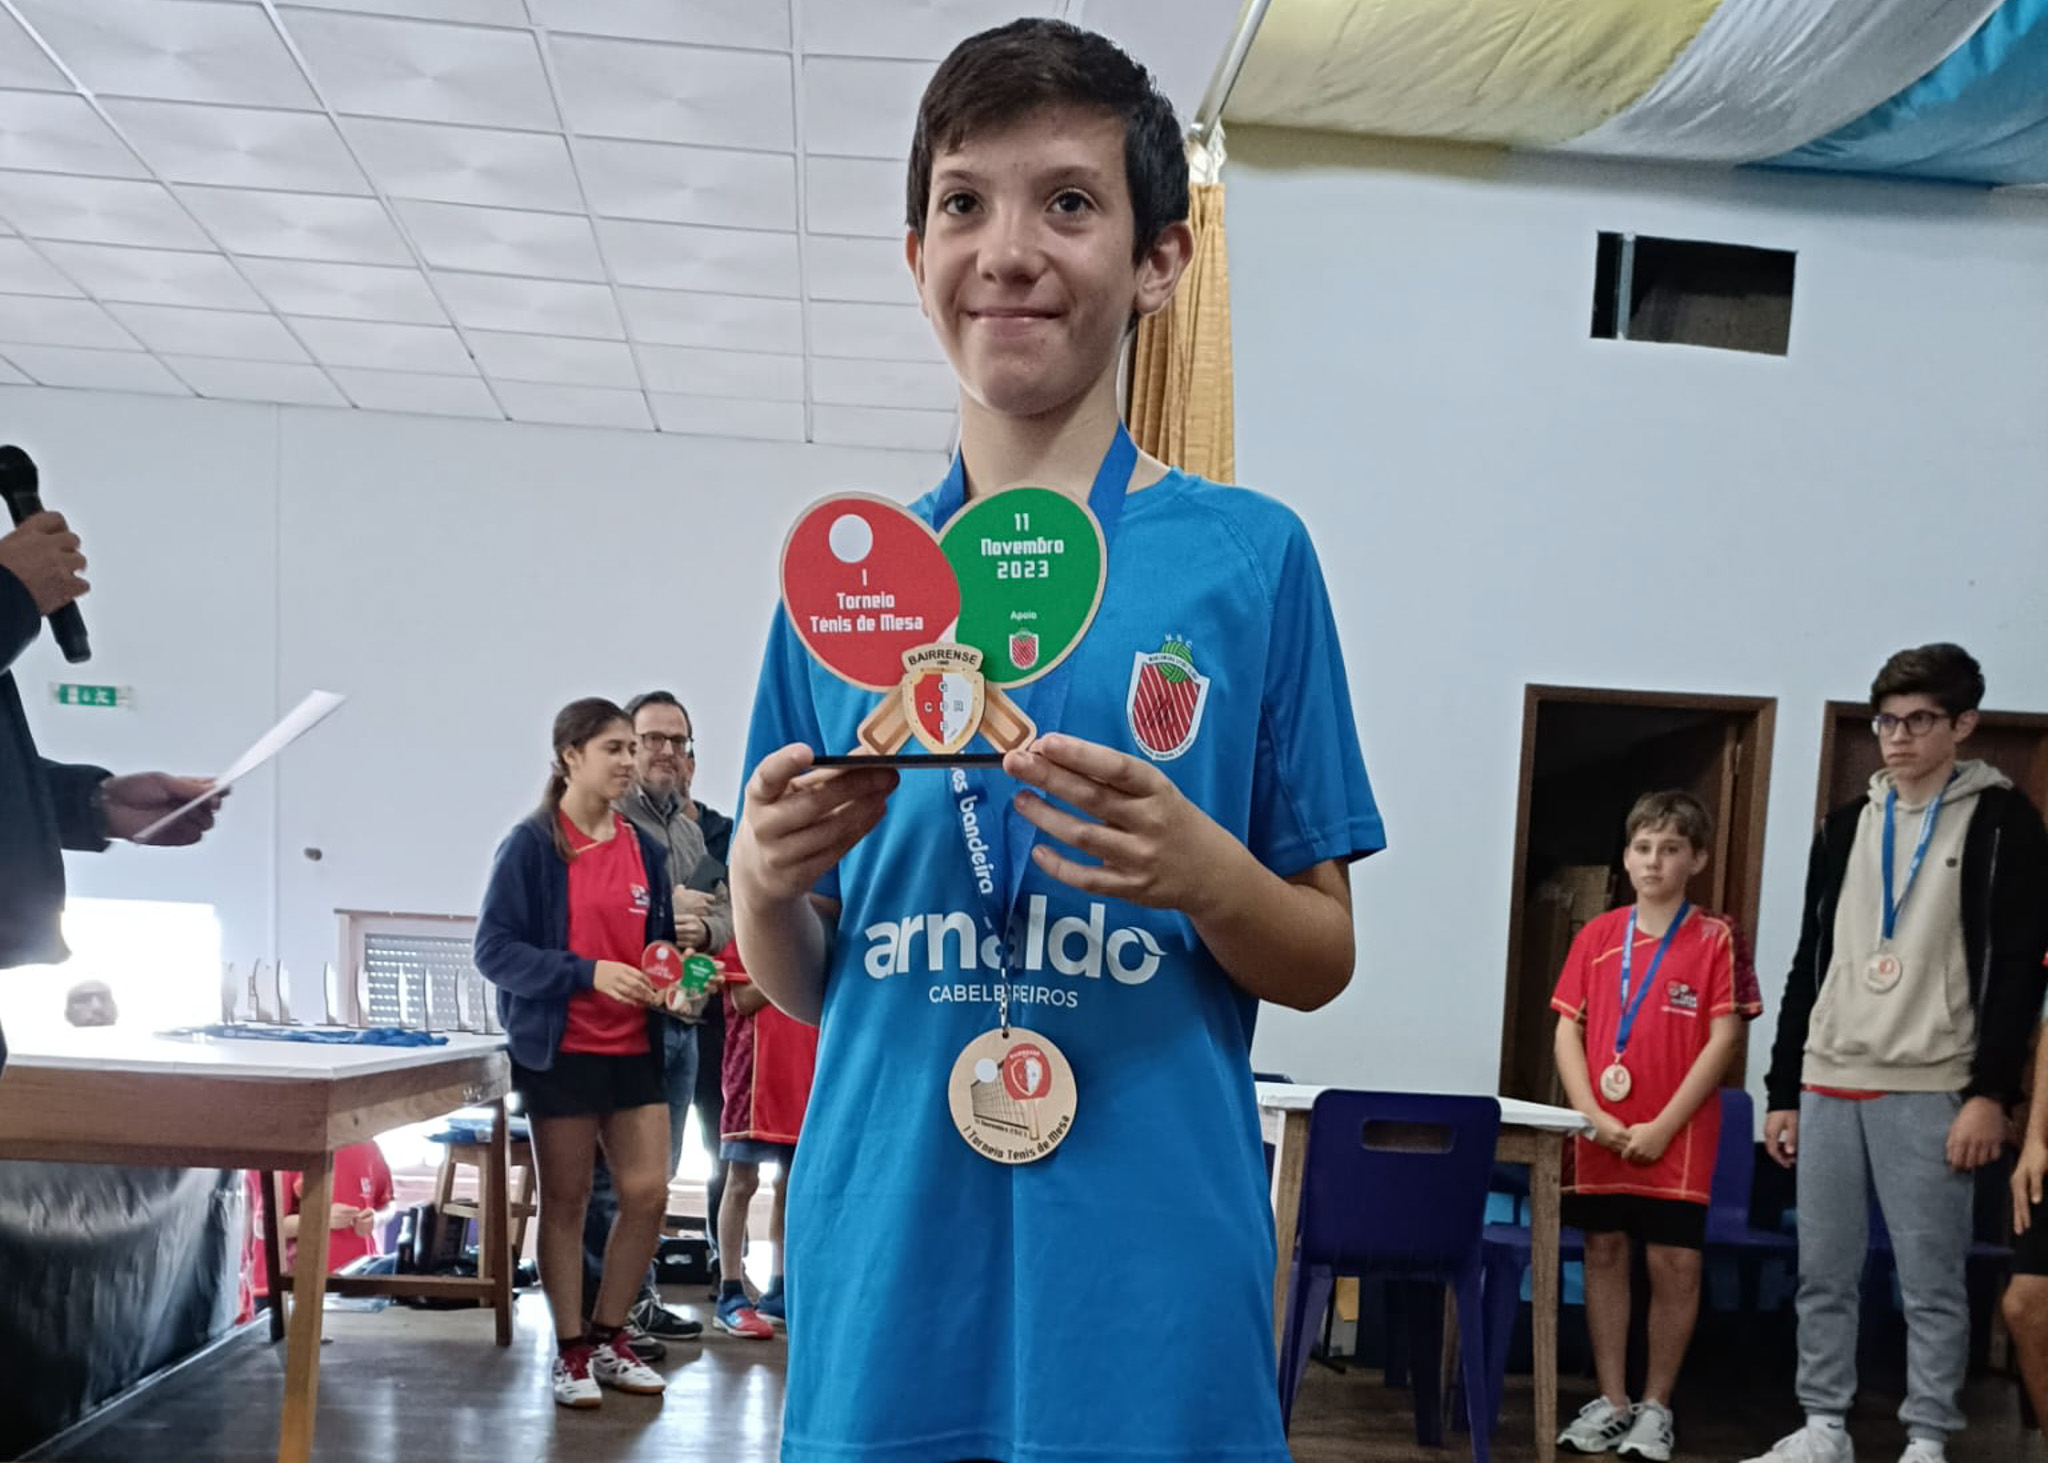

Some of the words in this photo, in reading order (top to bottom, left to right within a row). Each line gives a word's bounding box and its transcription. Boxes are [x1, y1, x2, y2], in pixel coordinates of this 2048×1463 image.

[1014, 513, 1029, 531] 11
[981, 537, 1064, 556] Novembro
[997, 560, 1049, 579] 2023
[836, 591, 895, 610] Torneio
[857, 614, 875, 632] de
[881, 614, 924, 631] Mesa
[1010, 610, 1037, 620] Apoio
[908, 649, 978, 665] BAIRRENSE
[960, 795, 994, 894] bandeira
[968, 1131, 1004, 1159] Torneio
[1037, 1142, 1051, 1154] de
[1048, 1115, 1070, 1143] Mesa
